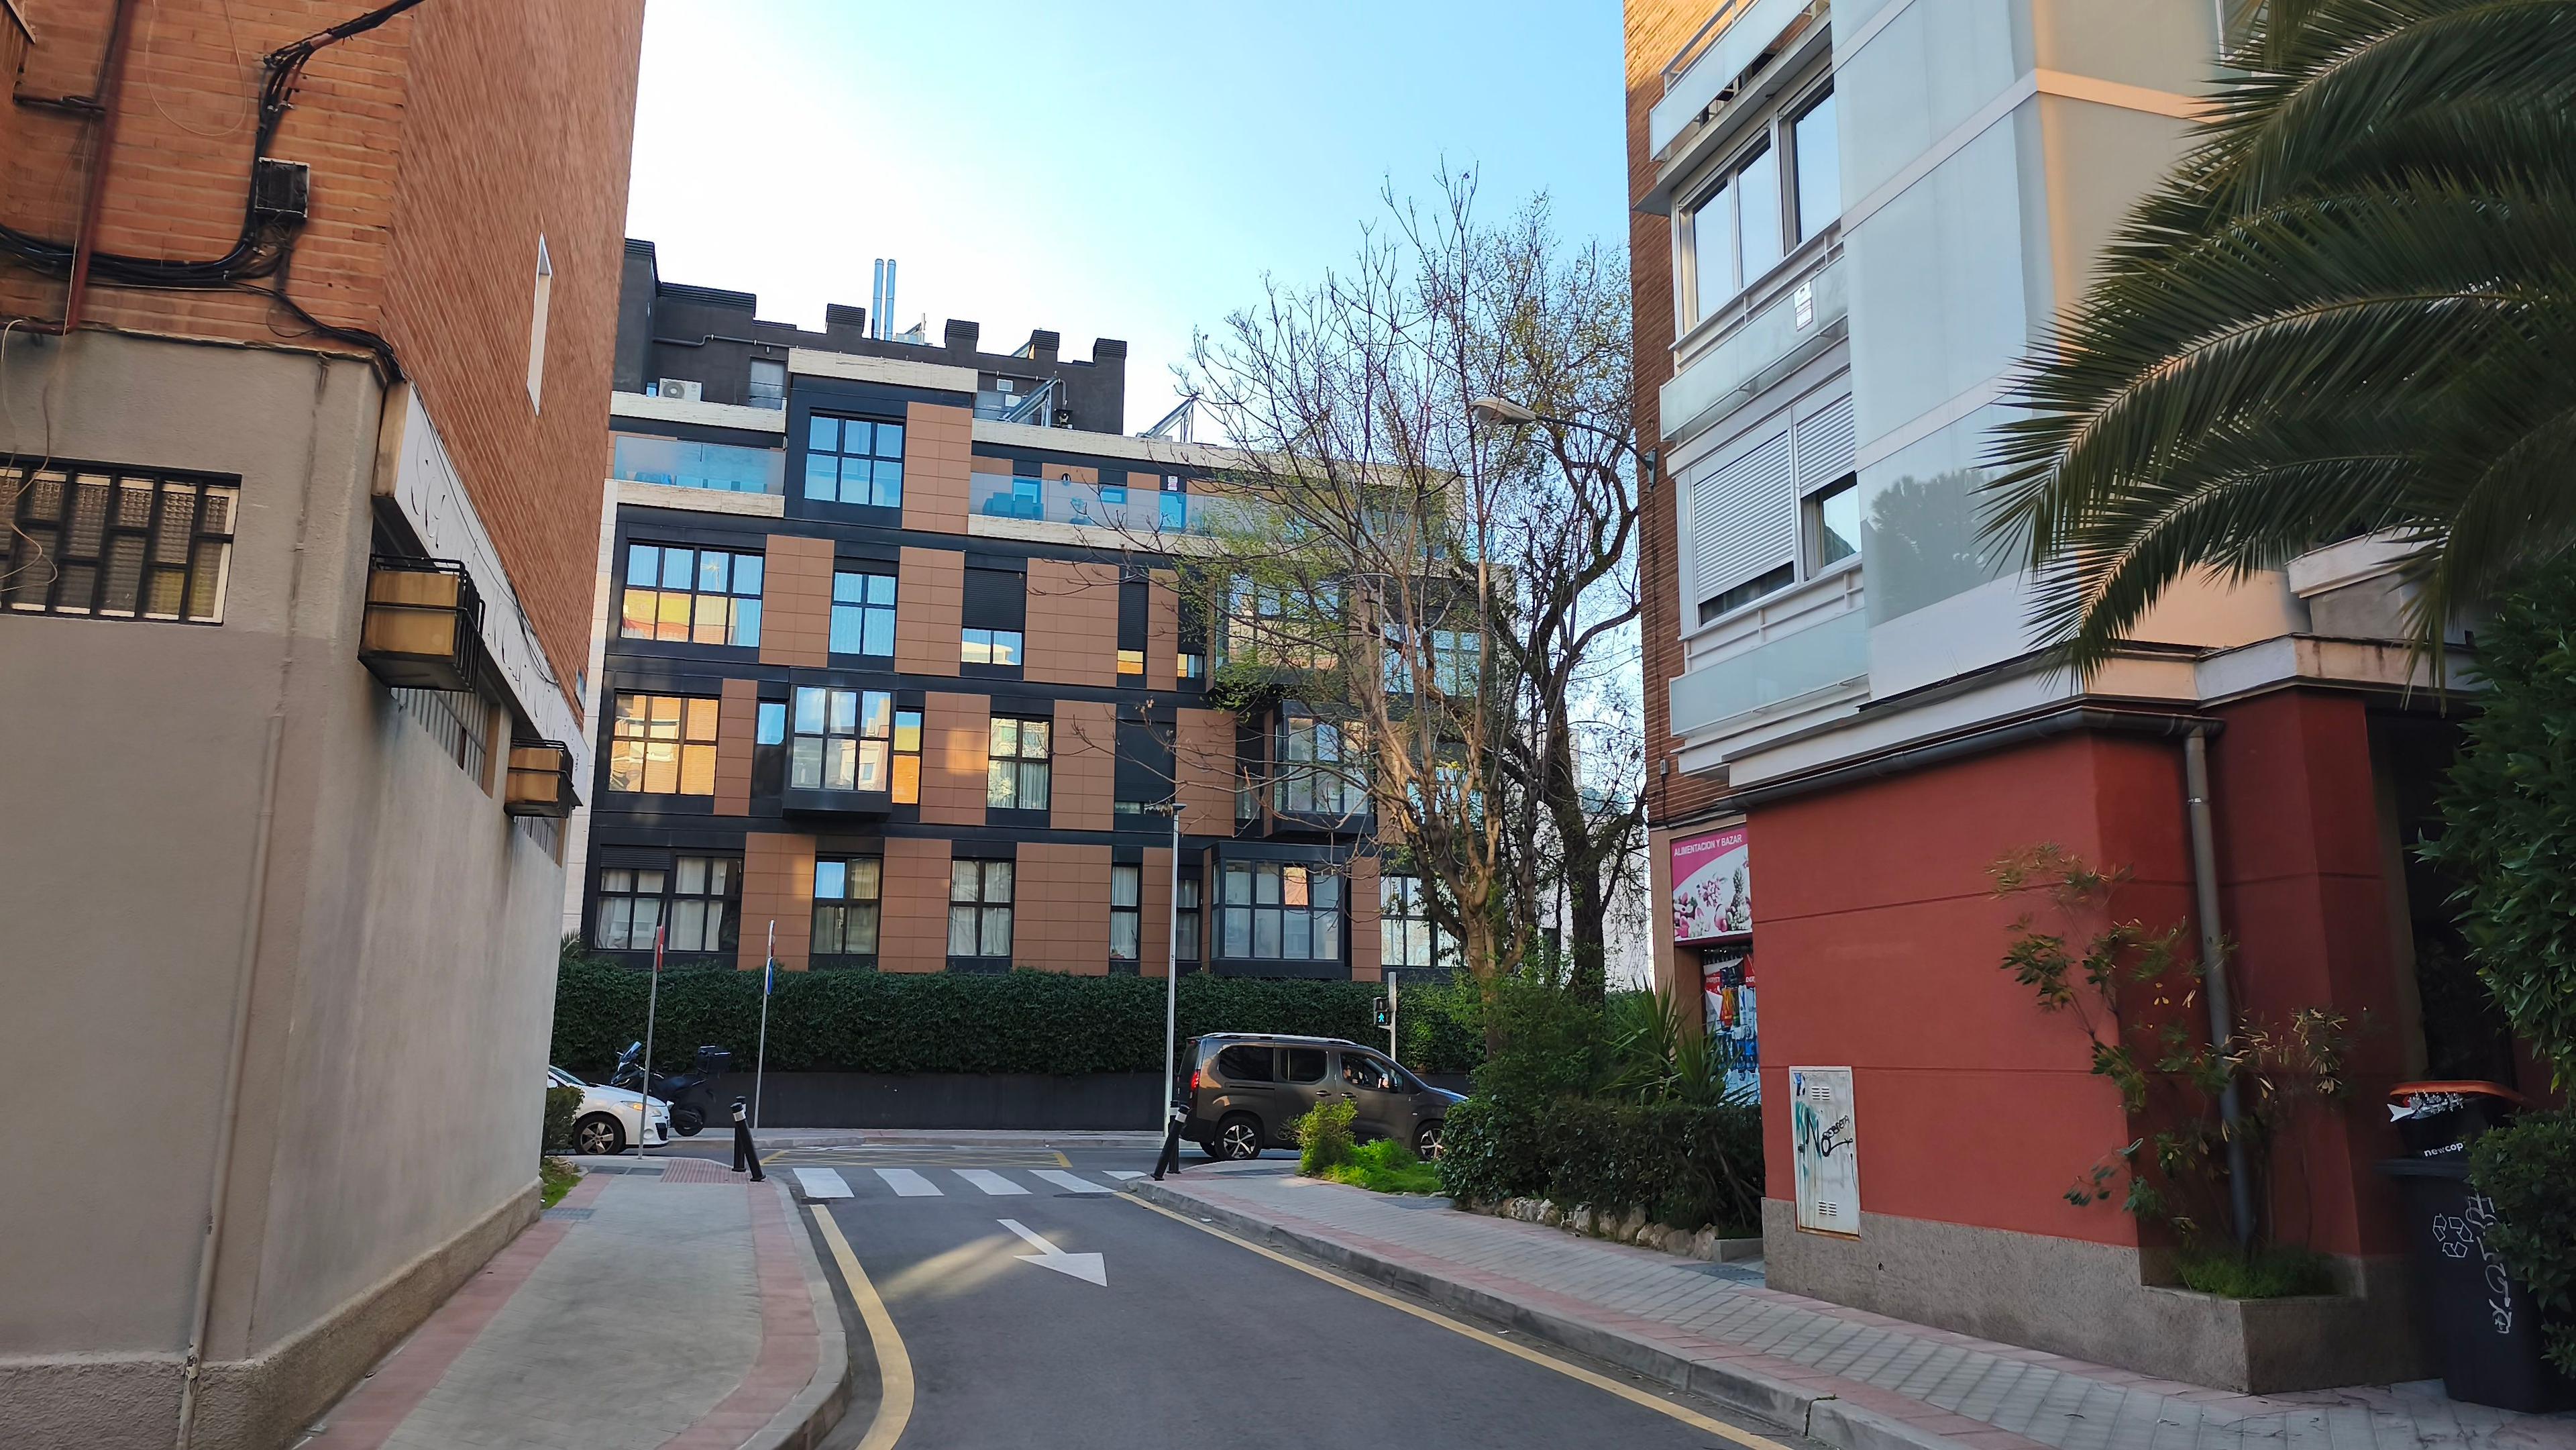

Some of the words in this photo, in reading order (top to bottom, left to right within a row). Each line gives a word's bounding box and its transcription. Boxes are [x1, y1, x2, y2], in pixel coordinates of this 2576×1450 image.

[1674, 841, 1715, 857] ALIMENTACION
[1716, 839, 1721, 847] Y
[1721, 834, 1743, 846] BAZAR
[2424, 1142, 2464, 1157] newcop
